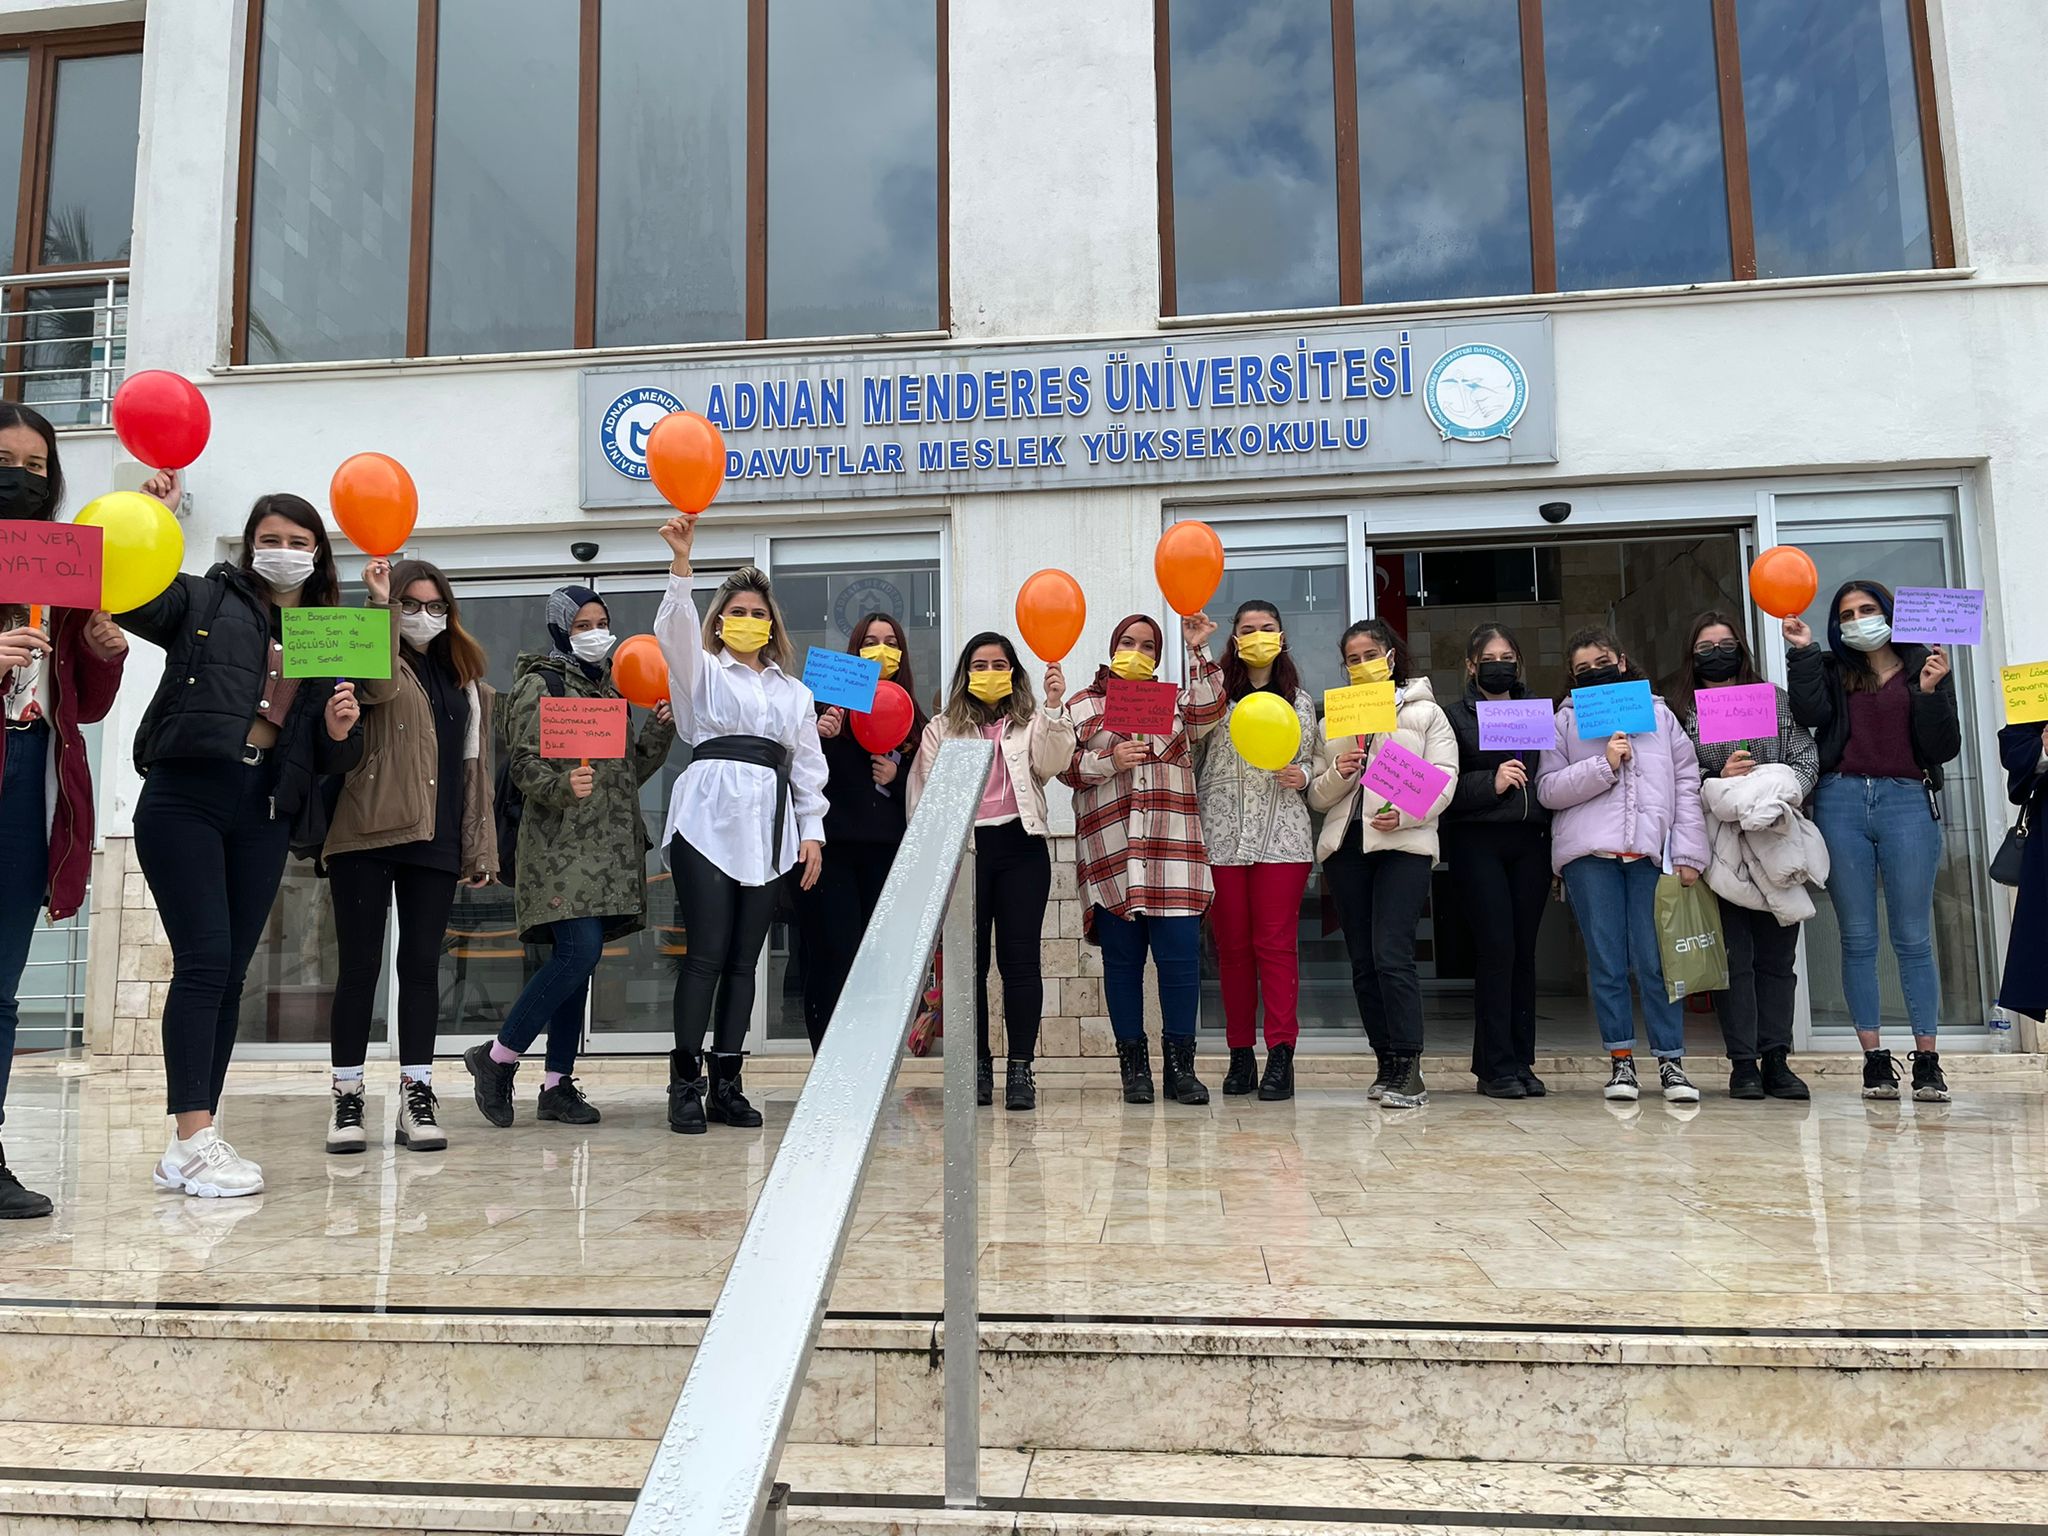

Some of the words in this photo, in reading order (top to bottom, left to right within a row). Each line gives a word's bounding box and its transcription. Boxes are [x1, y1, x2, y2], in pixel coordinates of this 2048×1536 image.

[705, 377, 846, 431] ADNAN
[863, 365, 1091, 426] MENDERES
[1104, 330, 1414, 413] ÜNİVERSİTESİ
[604, 396, 634, 434] ADNAN
[639, 391, 681, 413] MENDE
[606, 441, 651, 476] ÜNİVER
[725, 442, 905, 480] DAVUTLAR
[919, 434, 1066, 471] MESLEK
[1082, 417, 1369, 464] YÜKSEKOKULU
[0, 529, 27, 544] AN
[37, 531, 82, 556] VER
[0, 555, 48, 574] YAT
[284, 612, 302, 621] Ben
[325, 627, 343, 636] Sen
[2002, 670, 2021, 681] Ben
